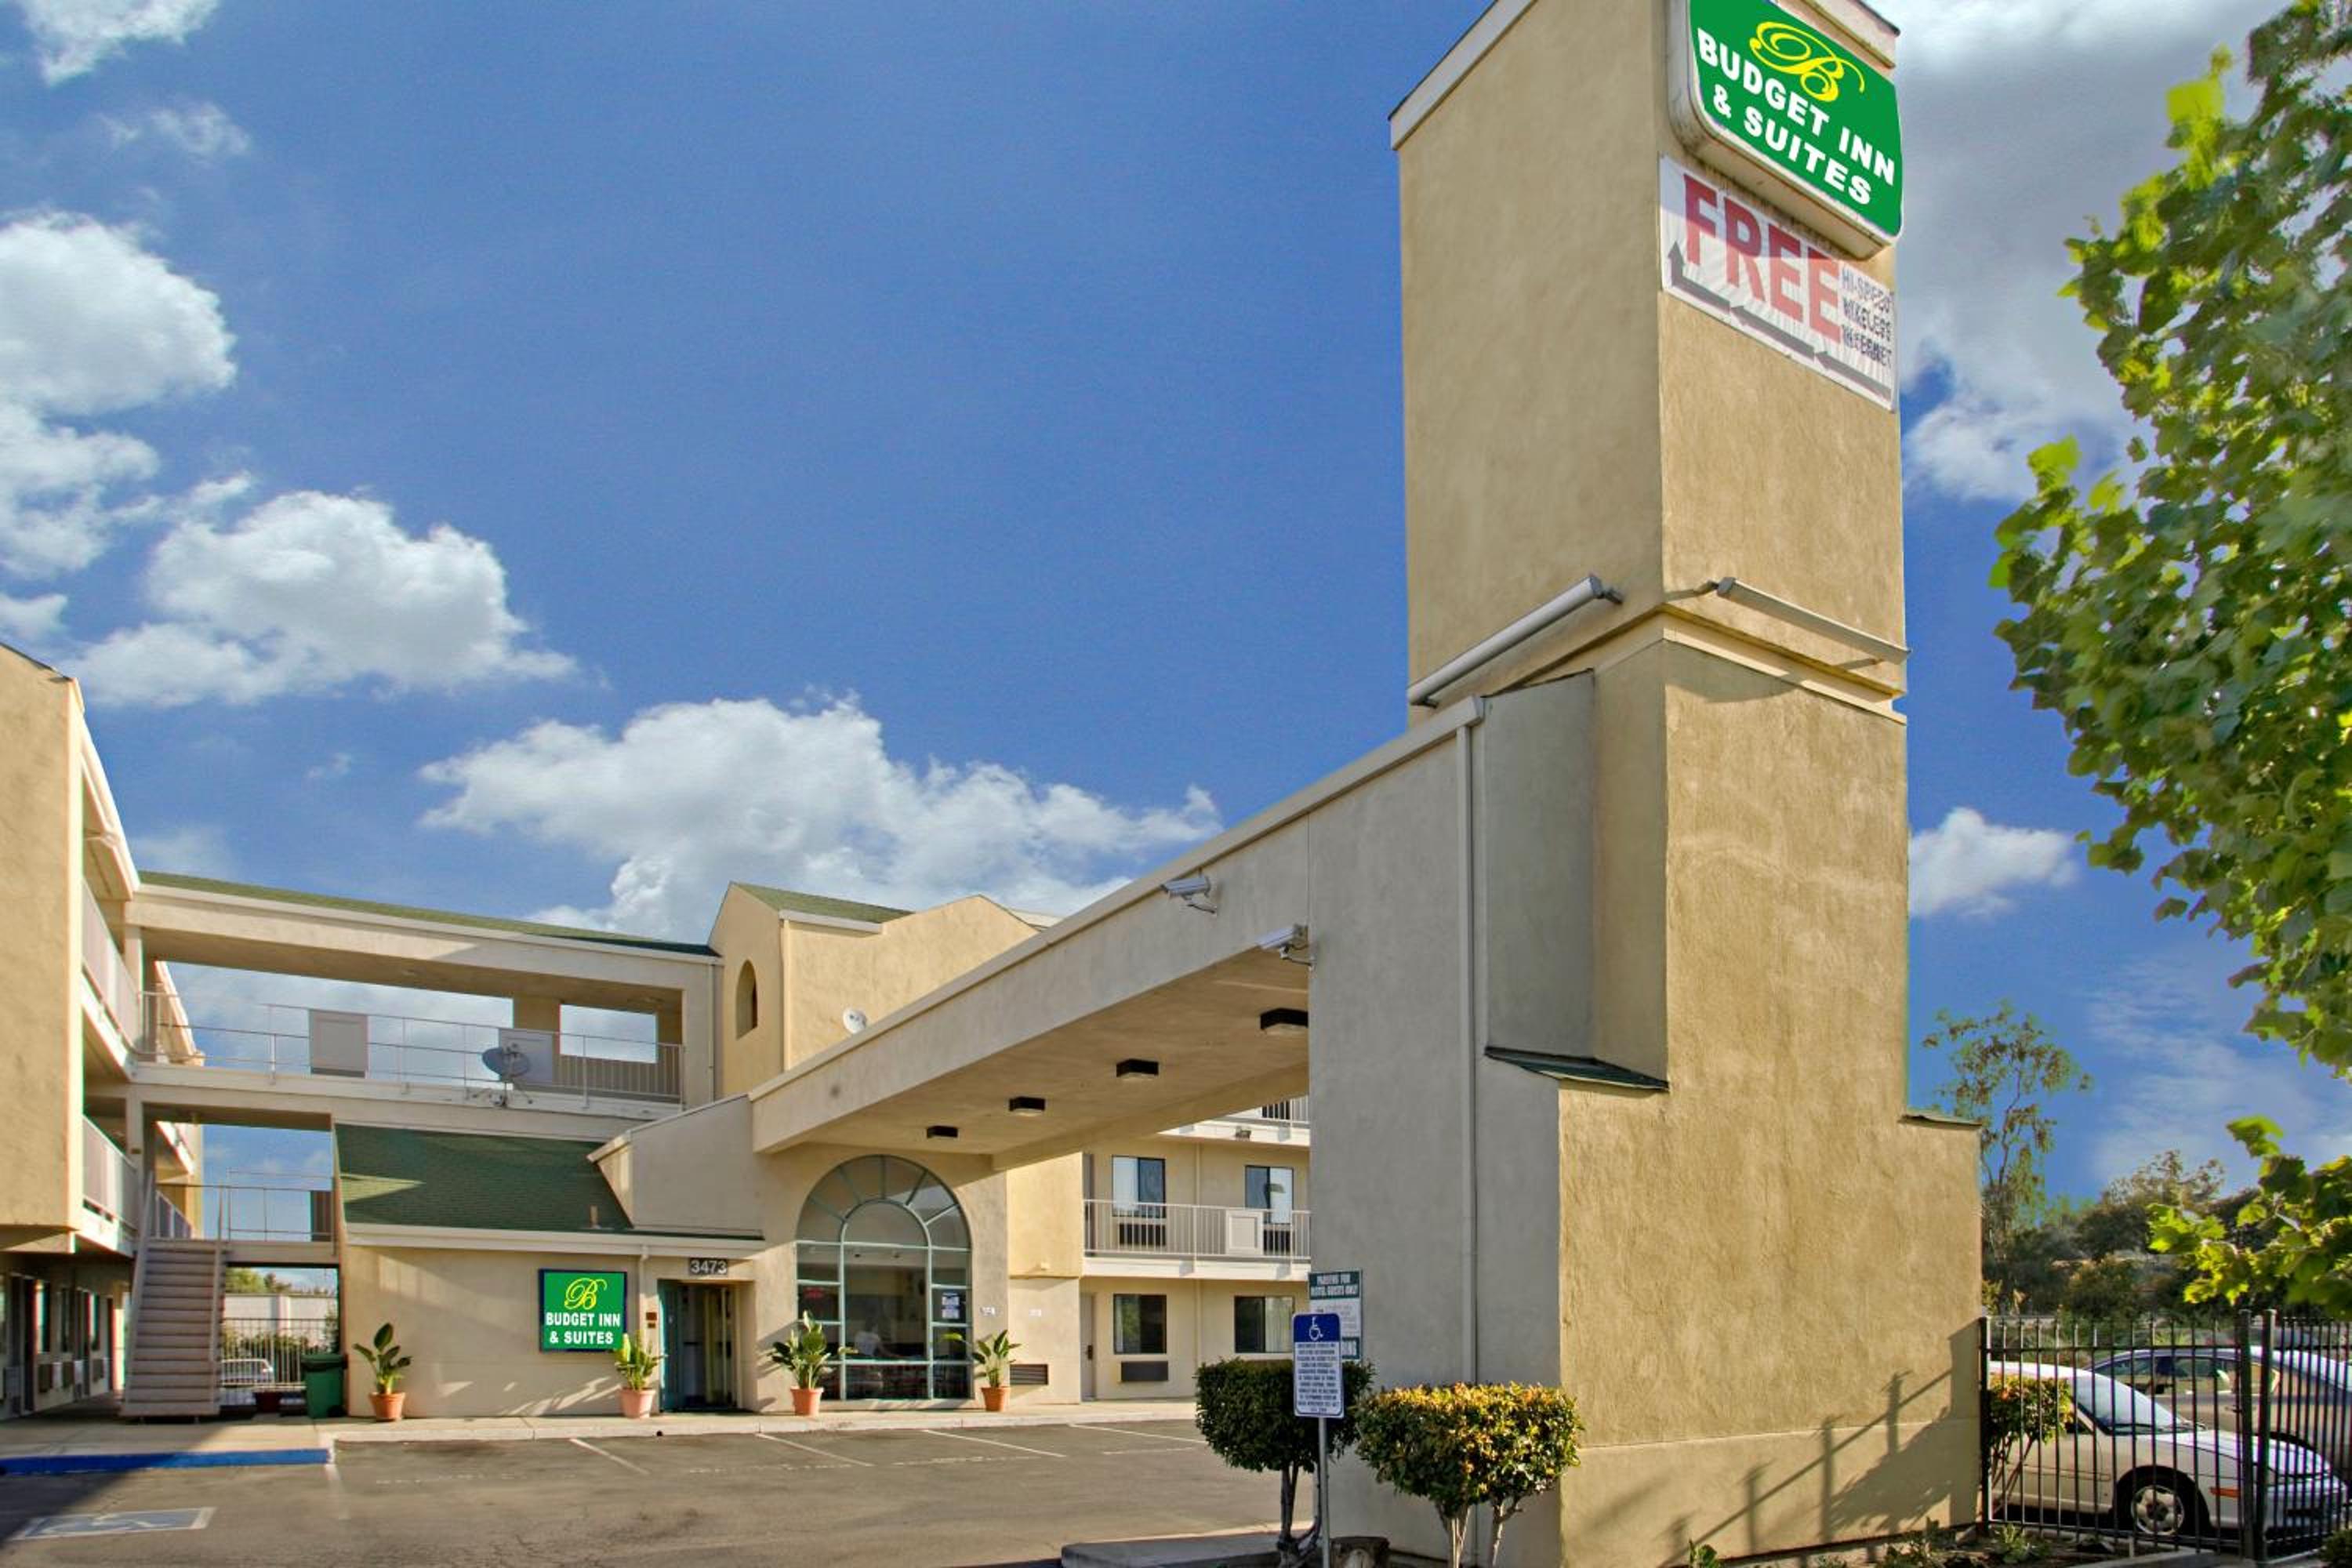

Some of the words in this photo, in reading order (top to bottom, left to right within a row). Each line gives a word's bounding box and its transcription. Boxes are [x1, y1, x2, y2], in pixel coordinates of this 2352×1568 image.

[1697, 28, 1829, 138] BUDGET
[1839, 126, 1895, 186] INN
[1713, 84, 1731, 118] &
[1744, 109, 1870, 205] SUITES
[1683, 173, 1842, 343] FREE
[691, 1261, 728, 1274] 3473
[546, 1312, 594, 1327] BUDGET
[599, 1313, 620, 1327] INN
[550, 1332, 558, 1344] &
[564, 1331, 614, 1345] SUITES
